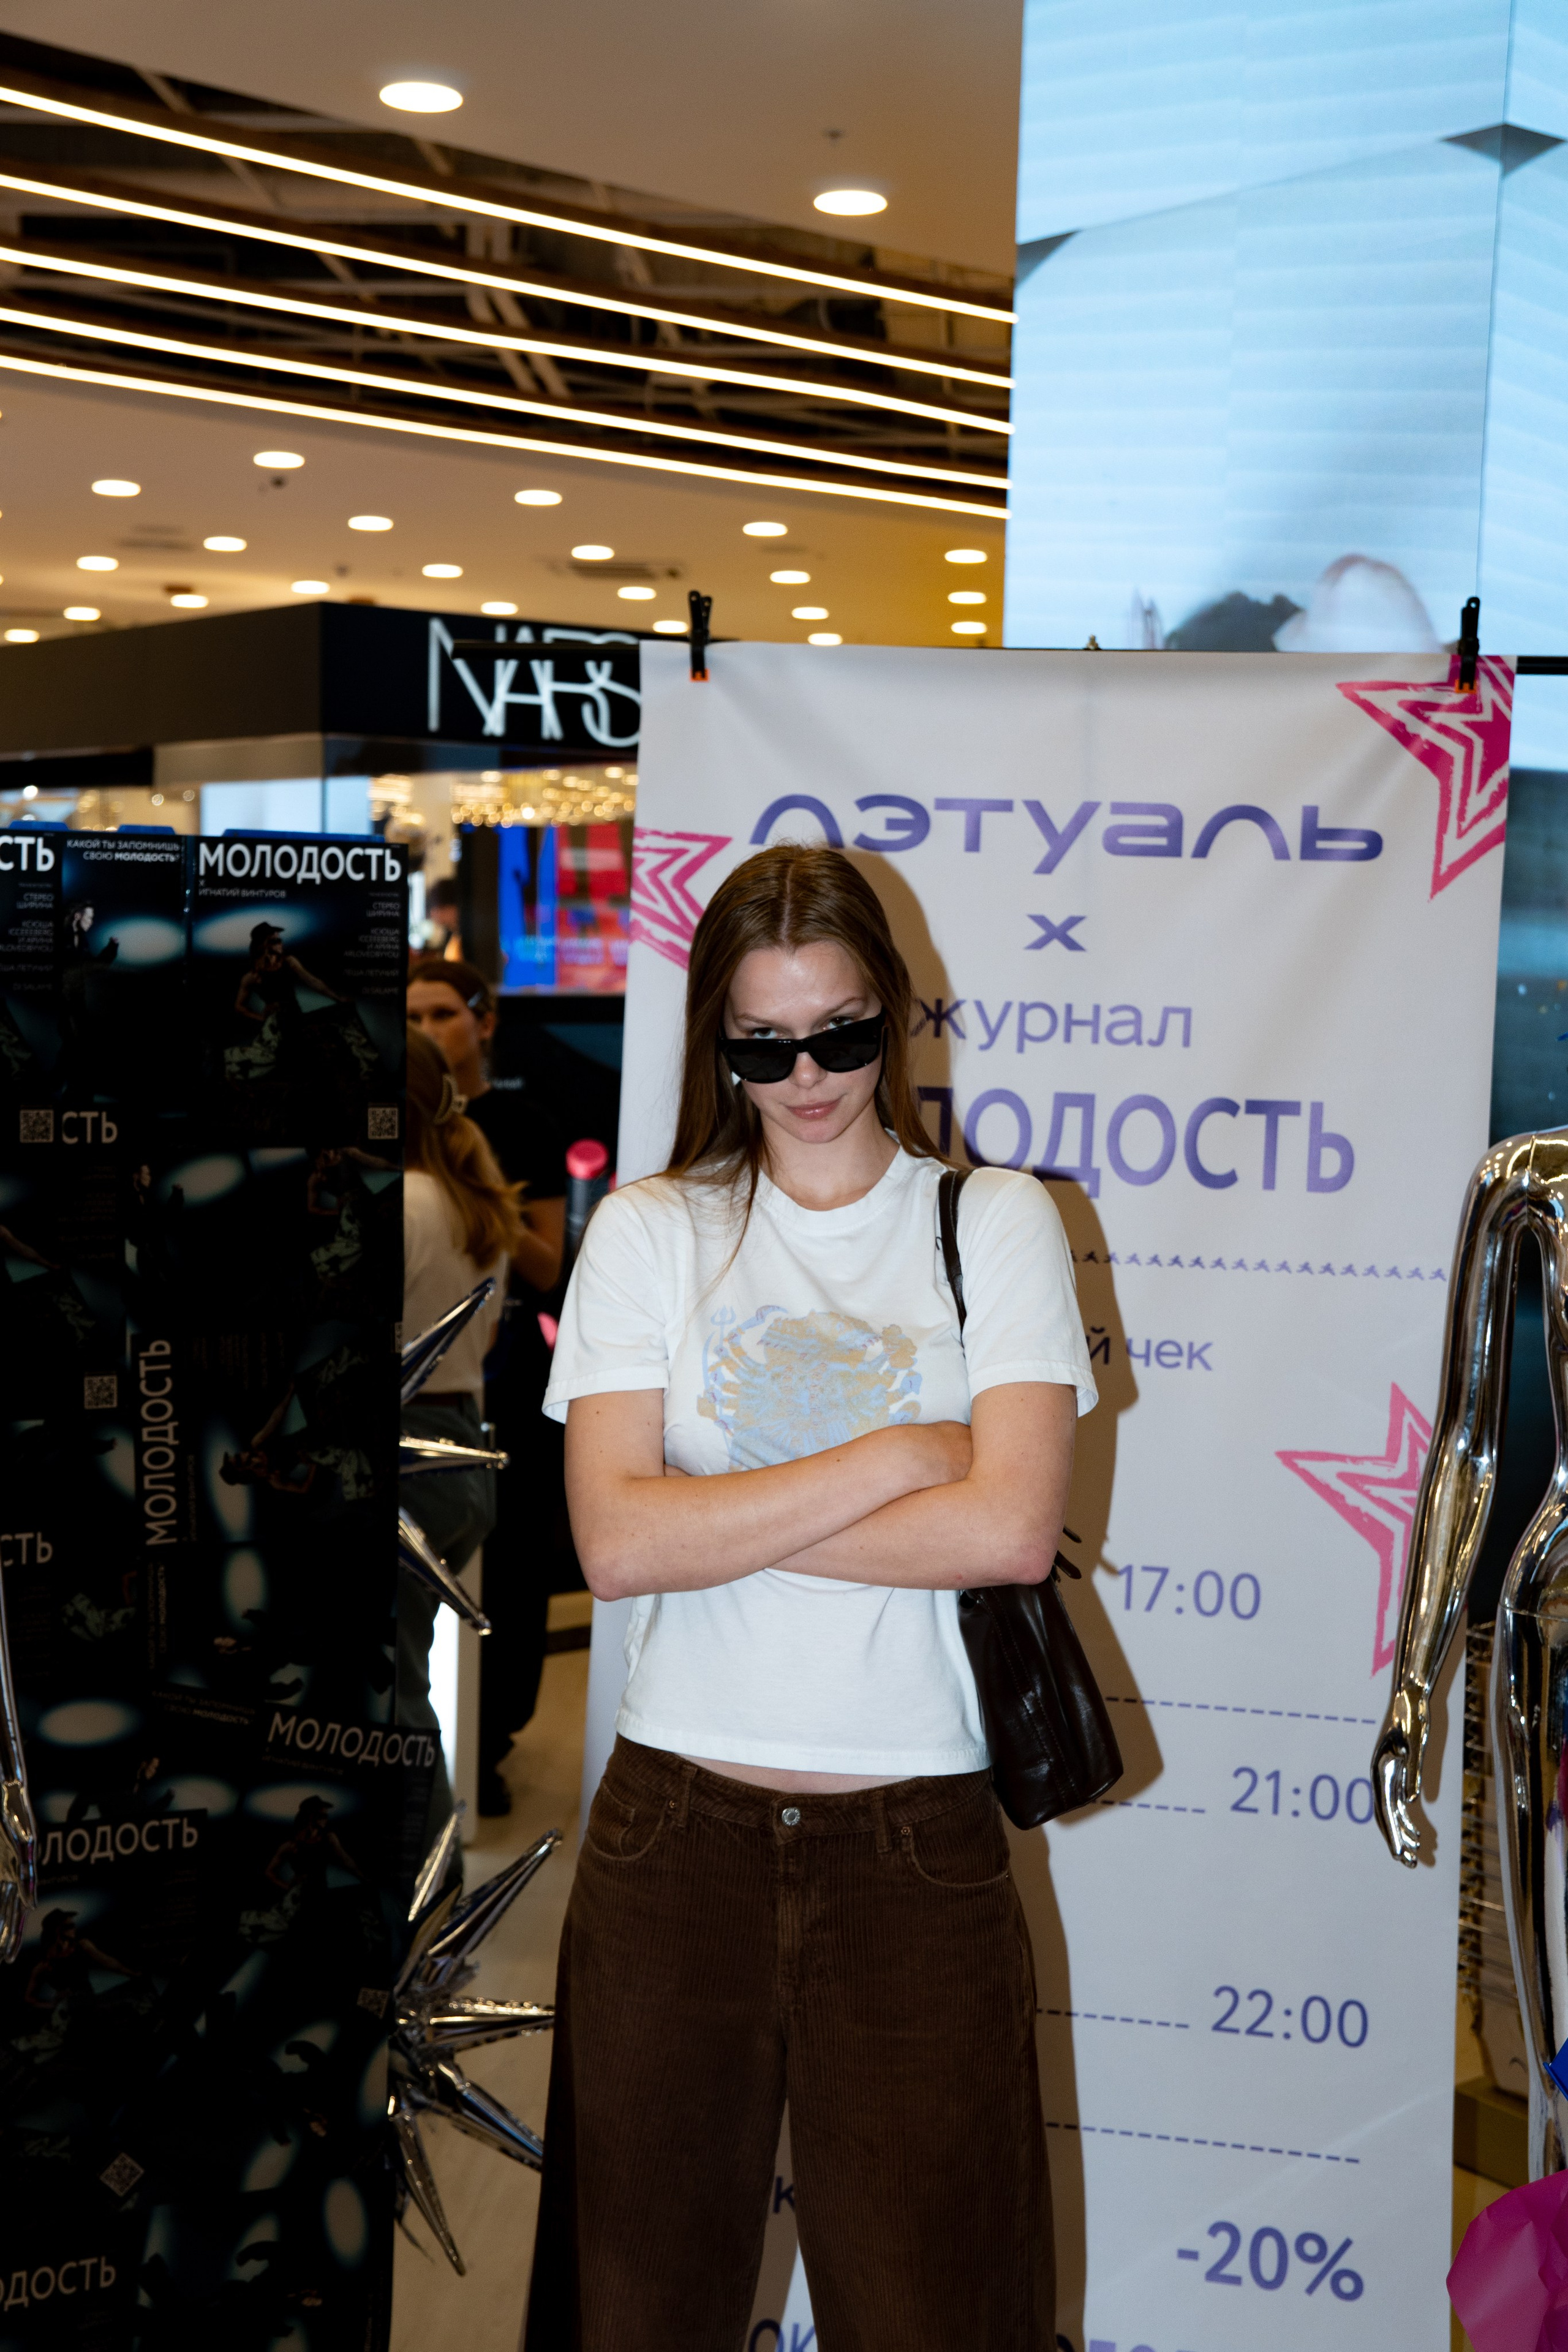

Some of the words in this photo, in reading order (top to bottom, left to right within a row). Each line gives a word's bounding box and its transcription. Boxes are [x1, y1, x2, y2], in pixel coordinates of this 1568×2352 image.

[429, 617, 641, 748] NARS
[66, 839, 101, 849] КАКОЙ
[102, 840, 116, 850] ТЫ
[117, 840, 181, 851] ЗАПОМНИШЬ
[83, 851, 113, 861] СВОЮ
[198, 842, 402, 885] МОЛОДОСТЬ
[198, 888, 240, 897] ИГНАТИЙ
[910, 998, 1193, 1054] журнал
[1126, 1338, 1213, 1371] чек
[138, 1339, 181, 1547] МОЛОДОСТЬ
[1117, 1564, 1262, 1621] 17:00
[267, 1710, 436, 1768] МОЛОДОСТЬ
[1230, 1766, 1374, 1825] 21:00
[37, 1816, 200, 1866] ЛОДОСТЬ
[1210, 1985, 1370, 2049] 22:00
[0, 2253, 118, 2312] ДОСТЬ
[1176, 2220, 1365, 2302] -20%
